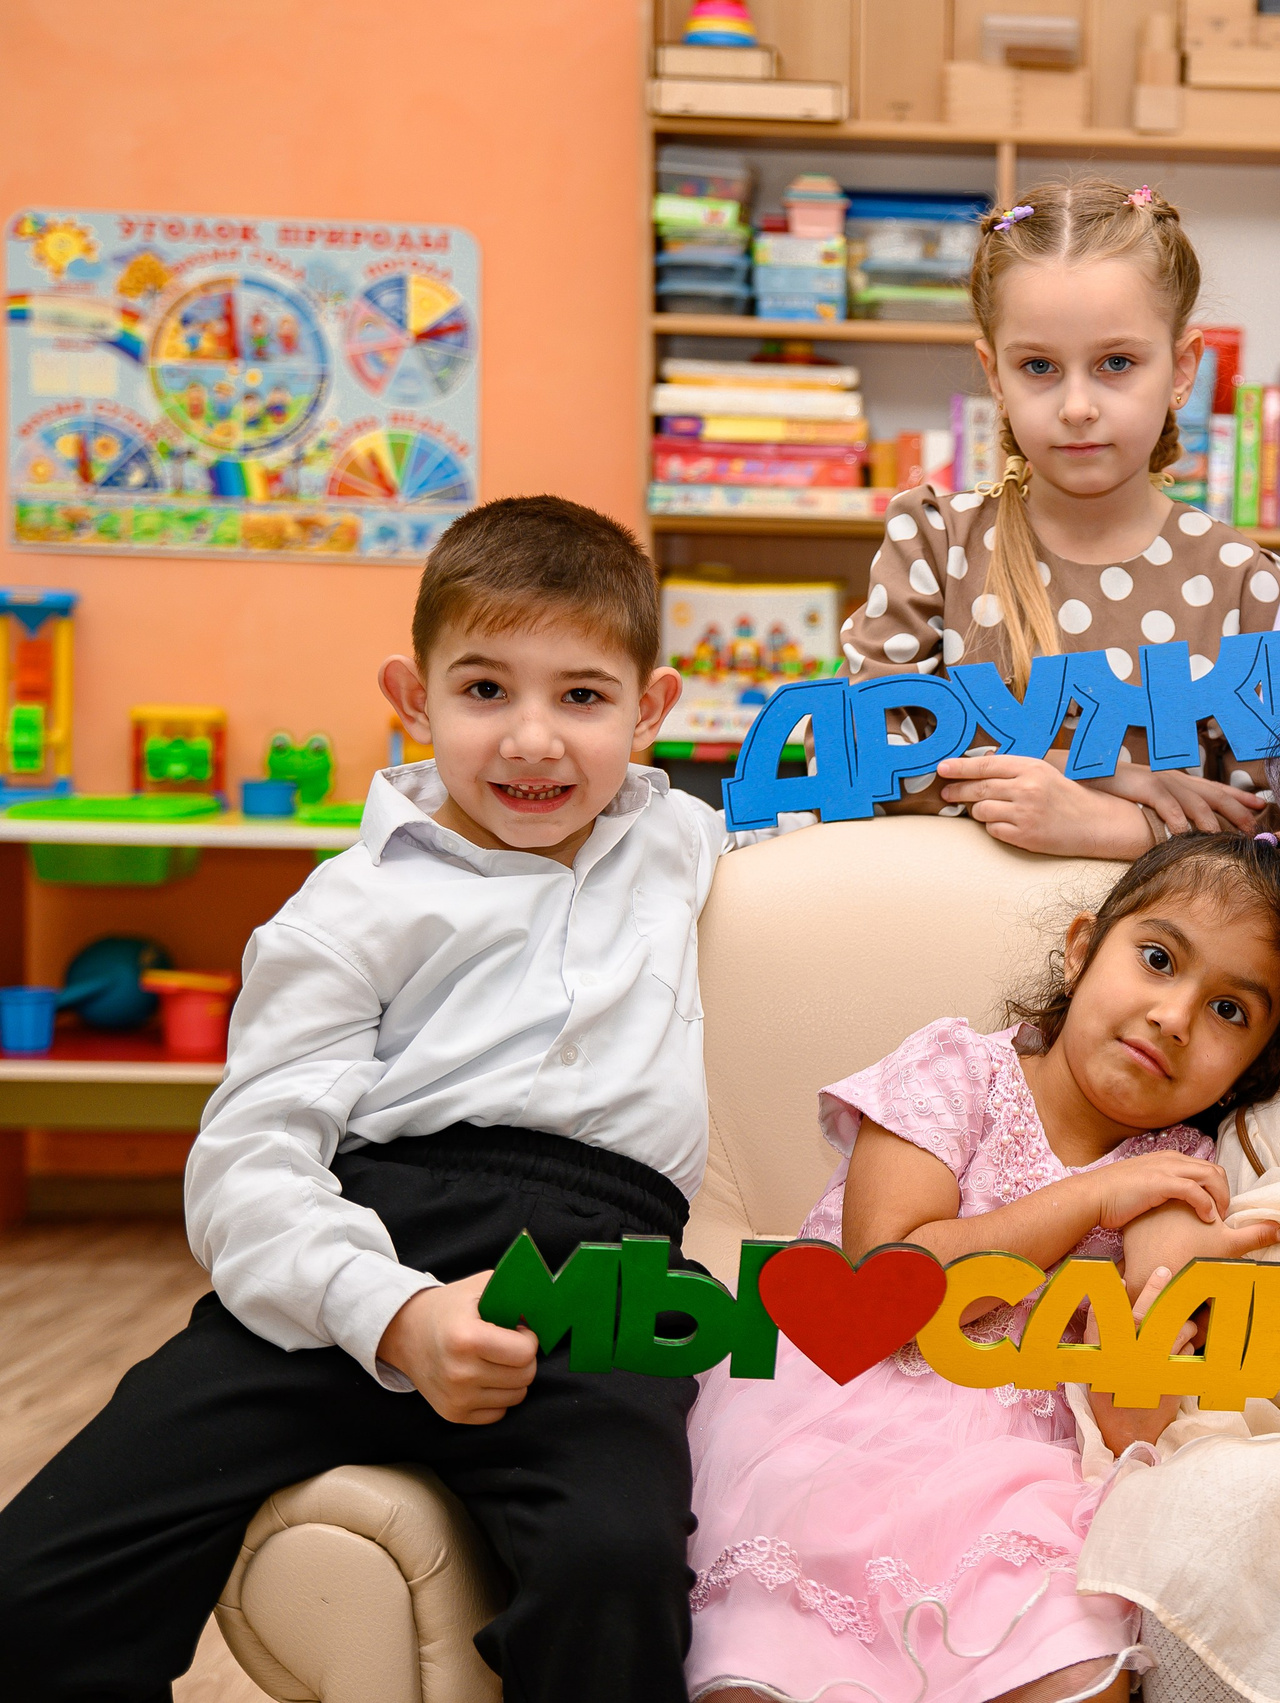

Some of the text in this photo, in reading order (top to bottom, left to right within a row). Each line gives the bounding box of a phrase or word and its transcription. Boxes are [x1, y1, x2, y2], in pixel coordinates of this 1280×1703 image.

[116, 217, 451, 253] УГОЛОК ПРИРОДЫ
[478, 1228, 788, 1379] МЫ
